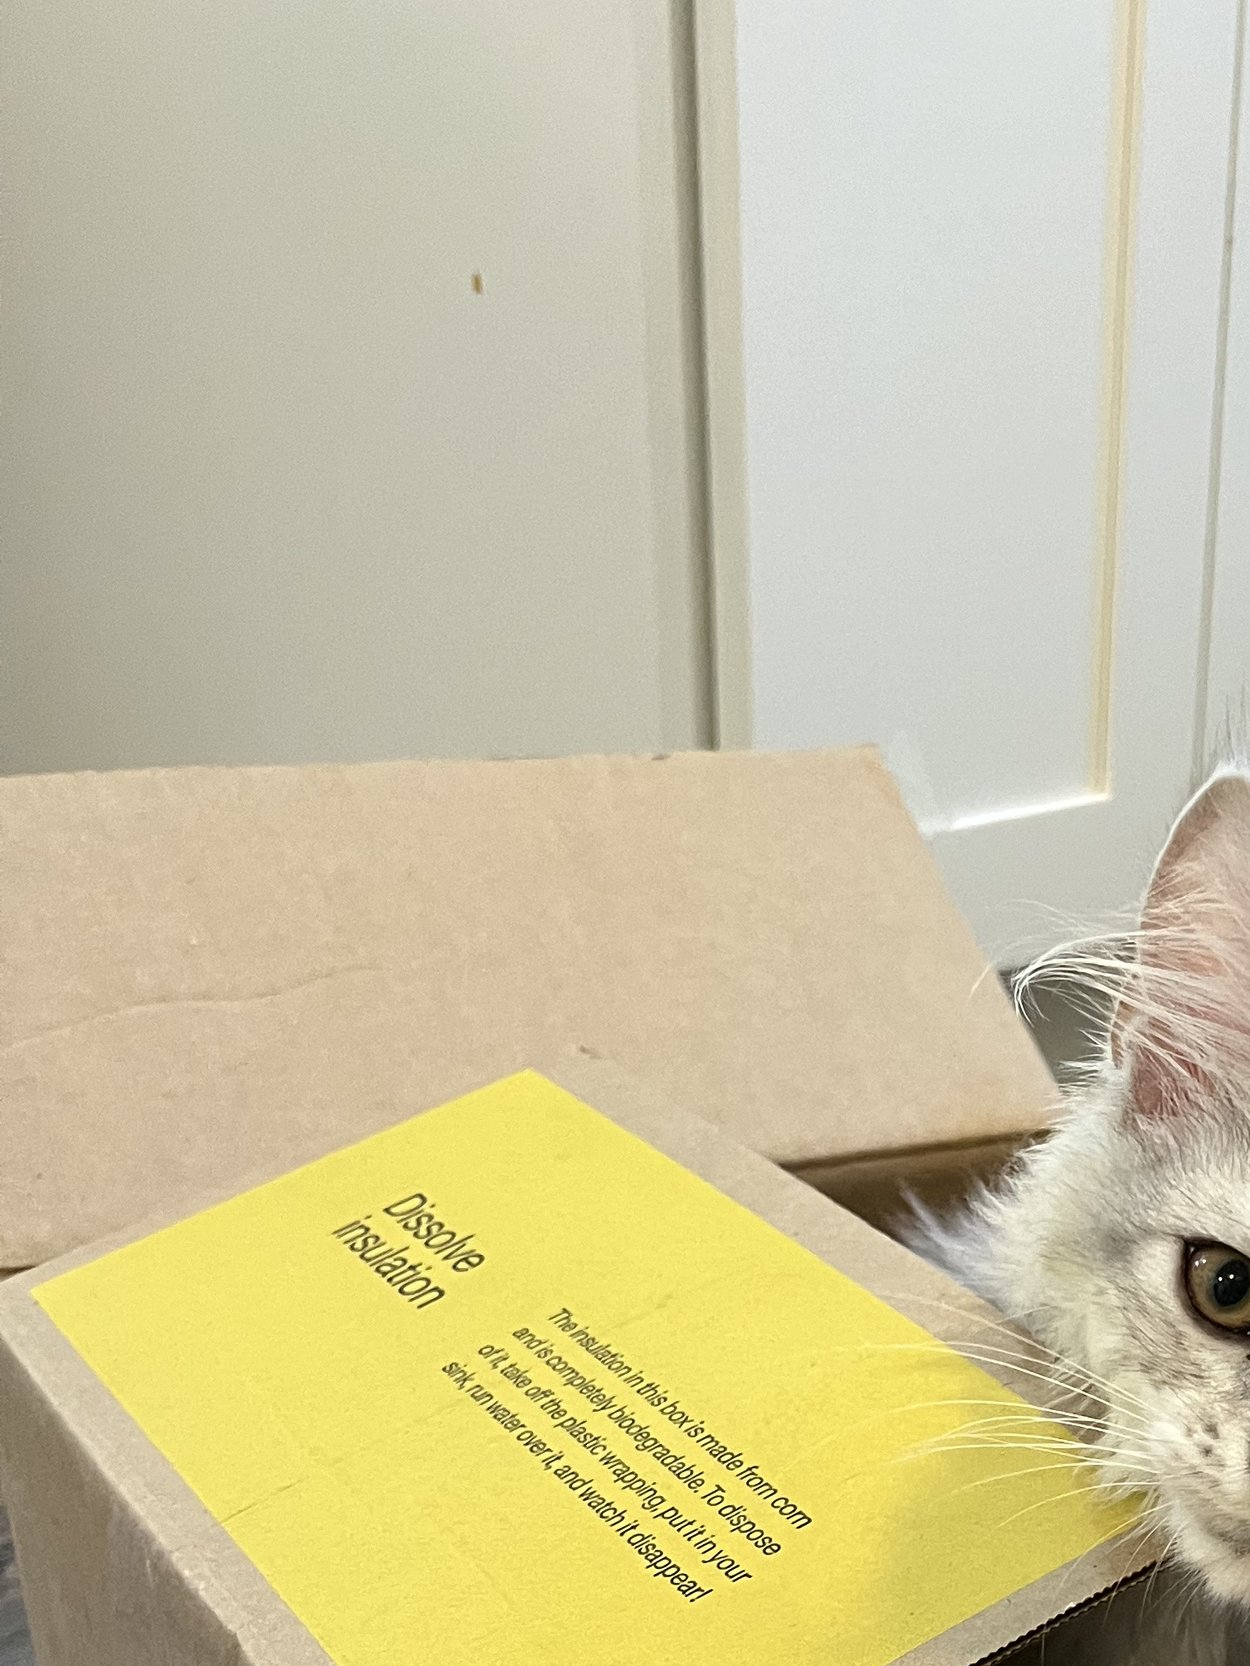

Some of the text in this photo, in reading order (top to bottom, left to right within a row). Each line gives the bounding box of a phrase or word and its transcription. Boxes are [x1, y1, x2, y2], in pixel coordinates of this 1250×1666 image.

[331, 1214, 446, 1310] insulation
[382, 1192, 486, 1274] Dissolve
[441, 1361, 714, 1603] sink, run water over it, and watch it disappear!
[478, 1344, 753, 1583] of it, take off the plastic wrapping, put it in your
[512, 1328, 781, 1556] and is completely biodegradable. To dispose
[548, 1308, 578, 1332] The
[568, 1326, 632, 1378] insulation
[623, 1371, 644, 1388] in
[636, 1382, 668, 1407] this
[660, 1401, 694, 1429] box
[684, 1421, 705, 1438] is
[696, 1434, 744, 1471] made
[736, 1465, 778, 1500] from
